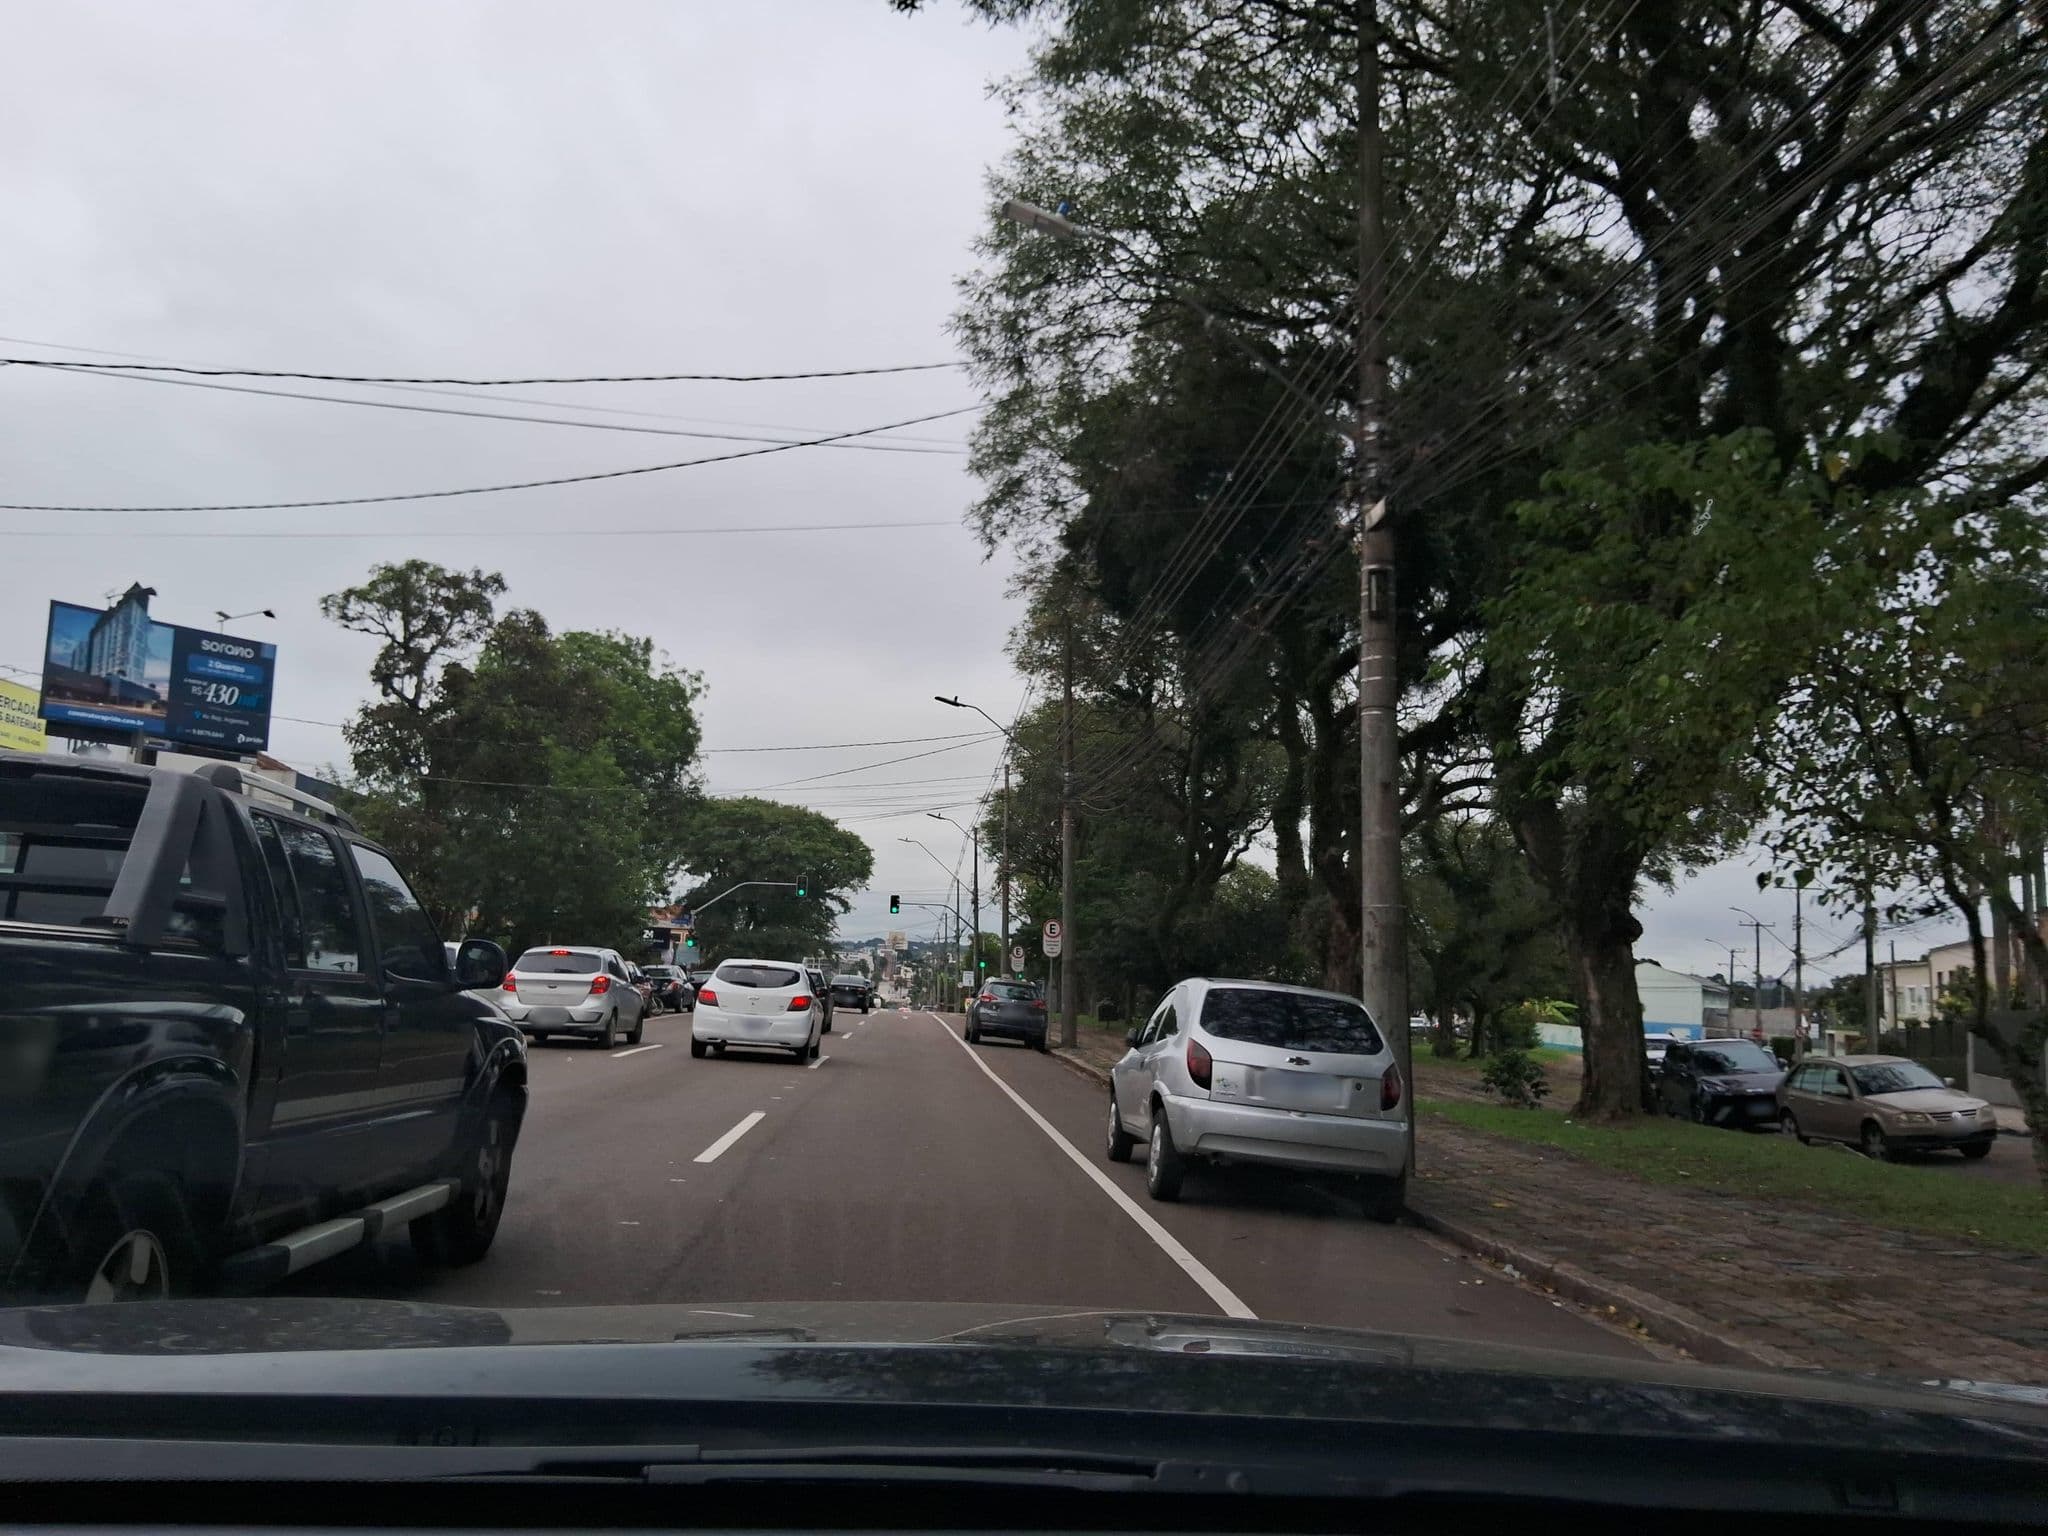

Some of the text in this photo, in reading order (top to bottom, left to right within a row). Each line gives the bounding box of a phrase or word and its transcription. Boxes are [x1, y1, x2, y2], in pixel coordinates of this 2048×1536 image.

[201, 639, 255, 659] sorano
[203, 683, 239, 706] 430
[6, 713, 42, 732] BATERIAS
[1050, 924, 1057, 934] E
